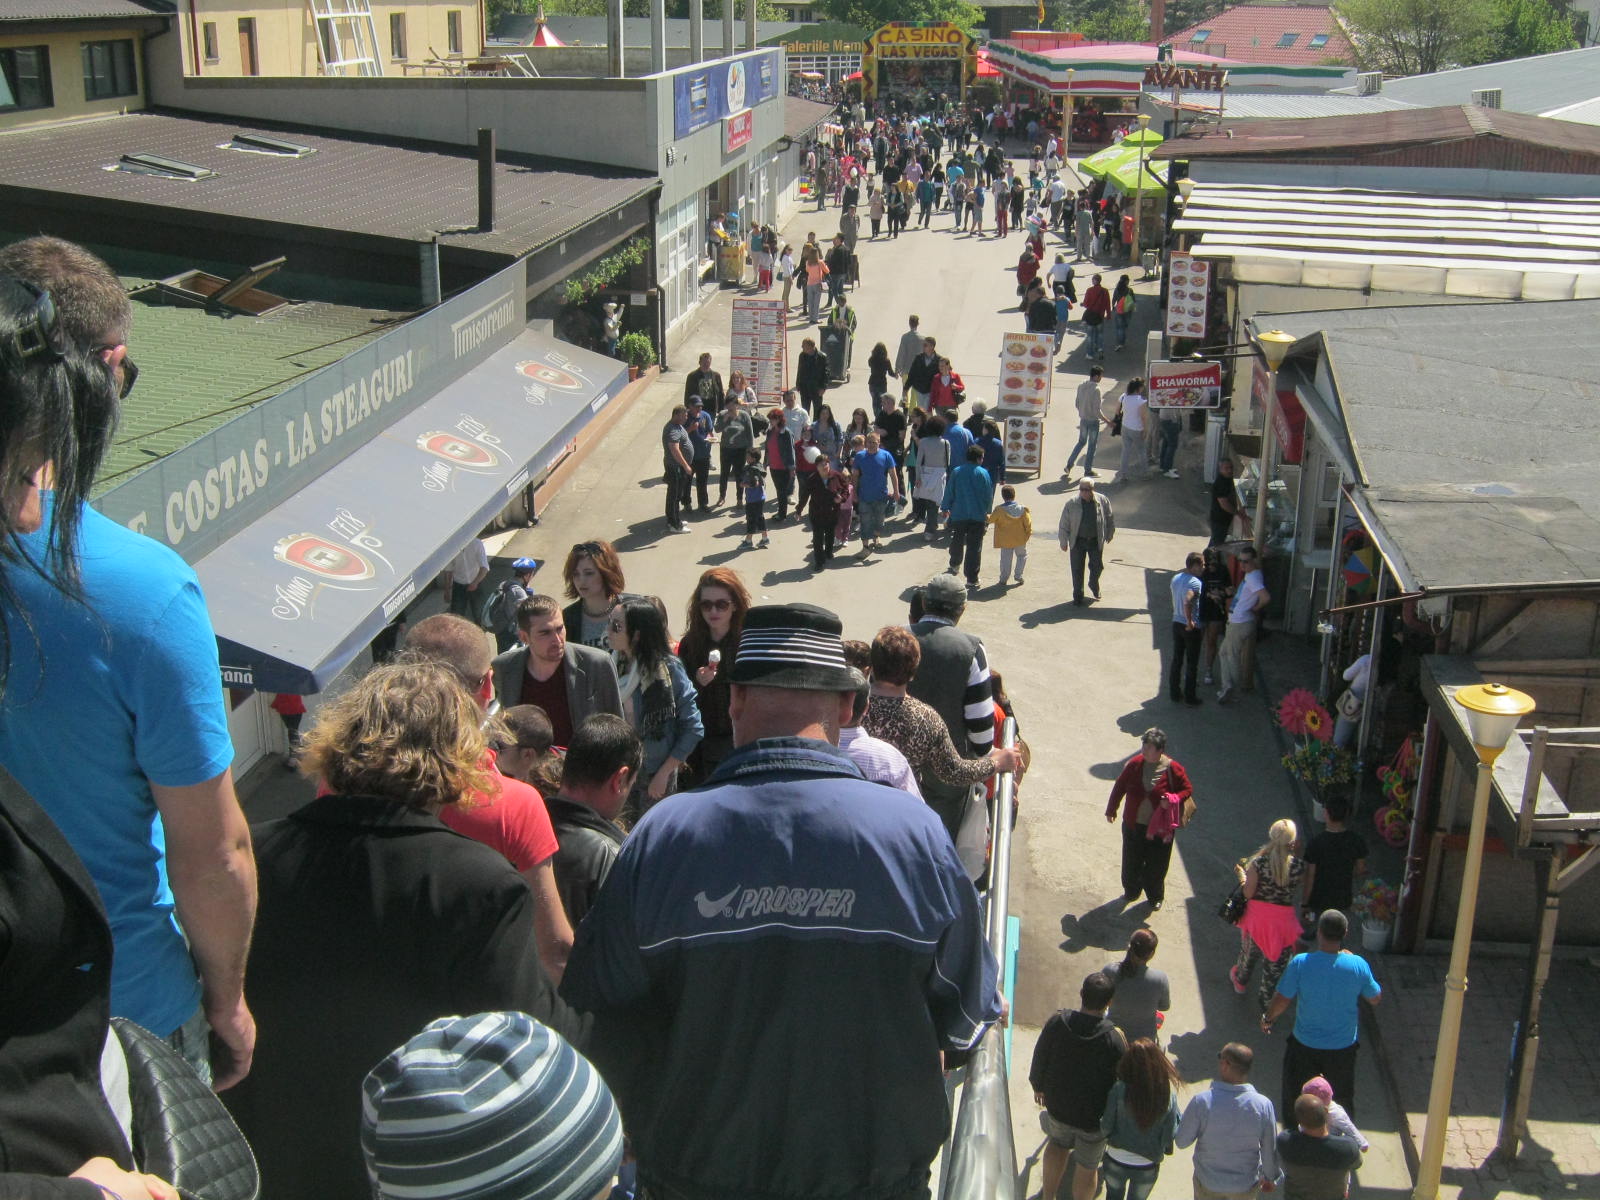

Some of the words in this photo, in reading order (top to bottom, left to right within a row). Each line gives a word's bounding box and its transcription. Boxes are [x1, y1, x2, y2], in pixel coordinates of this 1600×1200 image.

[877, 28, 963, 44] CASINO
[881, 46, 907, 58] LAS
[913, 46, 958, 58] VEGAS
[1156, 375, 1216, 388] SHAWORMA
[165, 438, 269, 545] COSTAS
[286, 411, 317, 468] LA
[320, 349, 414, 445] STEAGURI
[326, 507, 366, 540] 1718
[271, 576, 314, 620] Anno
[735, 885, 856, 919] PROSPER
